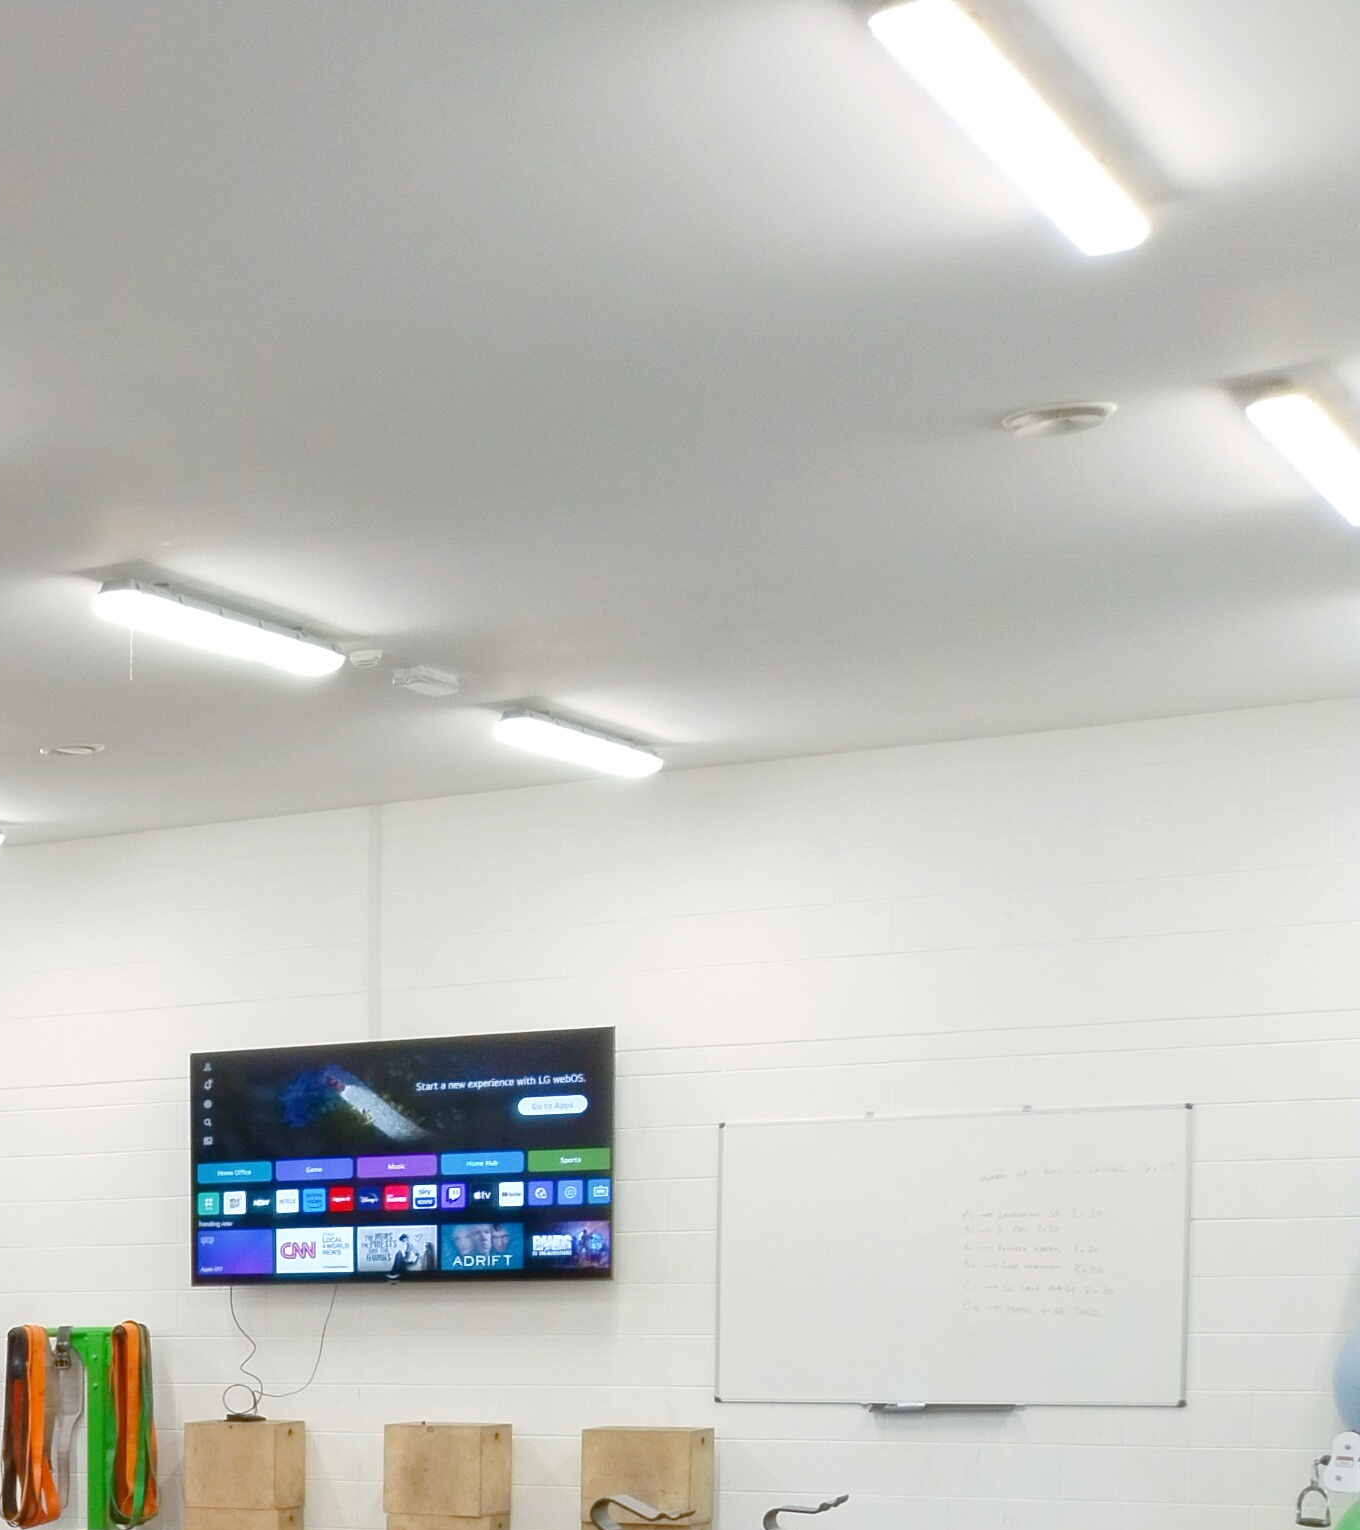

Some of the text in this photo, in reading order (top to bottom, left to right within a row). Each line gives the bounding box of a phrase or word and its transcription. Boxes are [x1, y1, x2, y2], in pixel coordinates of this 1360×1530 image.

[416, 1082, 438, 1092] Start
[448, 1082, 465, 1090] new
[467, 1079, 514, 1091] experience
[517, 1076, 536, 1086] with
[538, 1076, 551, 1085] LG
[553, 1073, 586, 1084] webOS.
[554, 1102, 574, 1111] Apps
[560, 1156, 582, 1165] Sports
[306, 1166, 323, 1174] Game
[280, 1241, 316, 1259] CNN
[452, 1254, 513, 1267] ADRIFT
